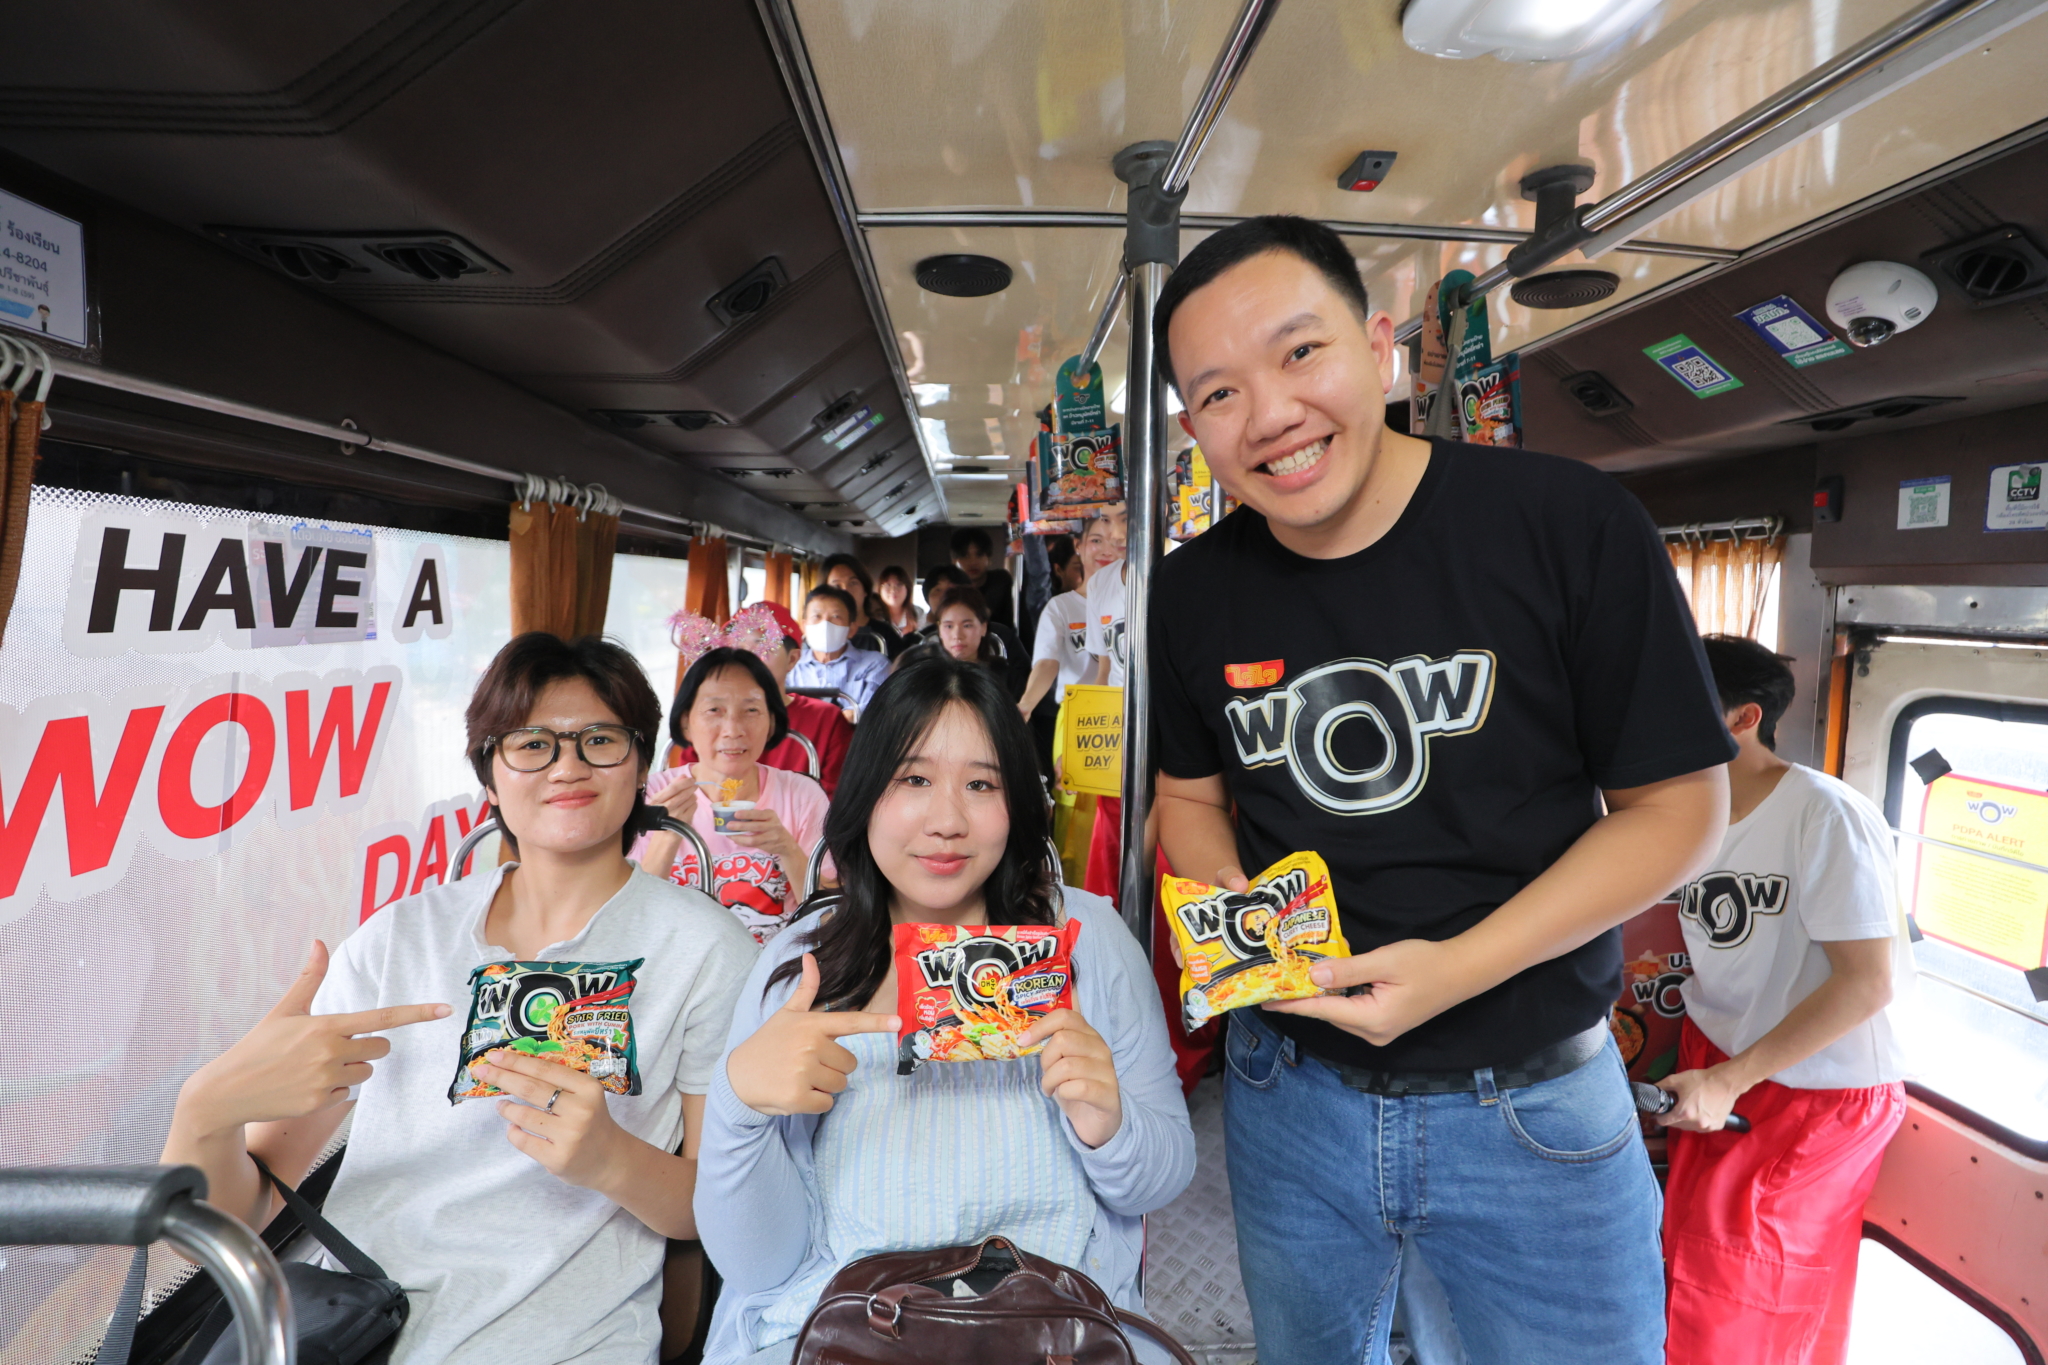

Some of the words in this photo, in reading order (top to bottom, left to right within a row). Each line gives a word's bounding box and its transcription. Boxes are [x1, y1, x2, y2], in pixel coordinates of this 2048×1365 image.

[8, 220, 60, 255] ร้องเรียน
[0, 247, 47, 272] 4-8204
[1051, 435, 1112, 470] WOW
[2010, 487, 2037, 497] CCTV
[87, 526, 367, 633] HAVE
[402, 558, 443, 628] A
[1077, 715, 1107, 727] HAVE
[1112, 715, 1120, 725] A
[1226, 652, 1493, 812] WOW
[1076, 733, 1120, 749] WOW
[1084, 755, 1112, 767] DAY
[0, 681, 392, 900] WOW
[1967, 800, 2016, 824] WOW
[1953, 824, 1983, 838] PDPA
[1986, 832, 2026, 848] ALERT
[1178, 869, 1307, 960] WOW
[1282, 909, 1326, 932] JAPANESE
[1283, 925, 1298, 938] CURRY
[1300, 922, 1326, 931] CHEESE
[918, 936, 1057, 1010] WOW
[1015, 975, 1064, 994] KOREAN
[478, 972, 618, 1037] WOW
[1015, 992, 1034, 1000] SPICY
[1632, 973, 1690, 1018] WO
[567, 1012, 594, 1024] STIR
[597, 1011, 629, 1022] FRIED
